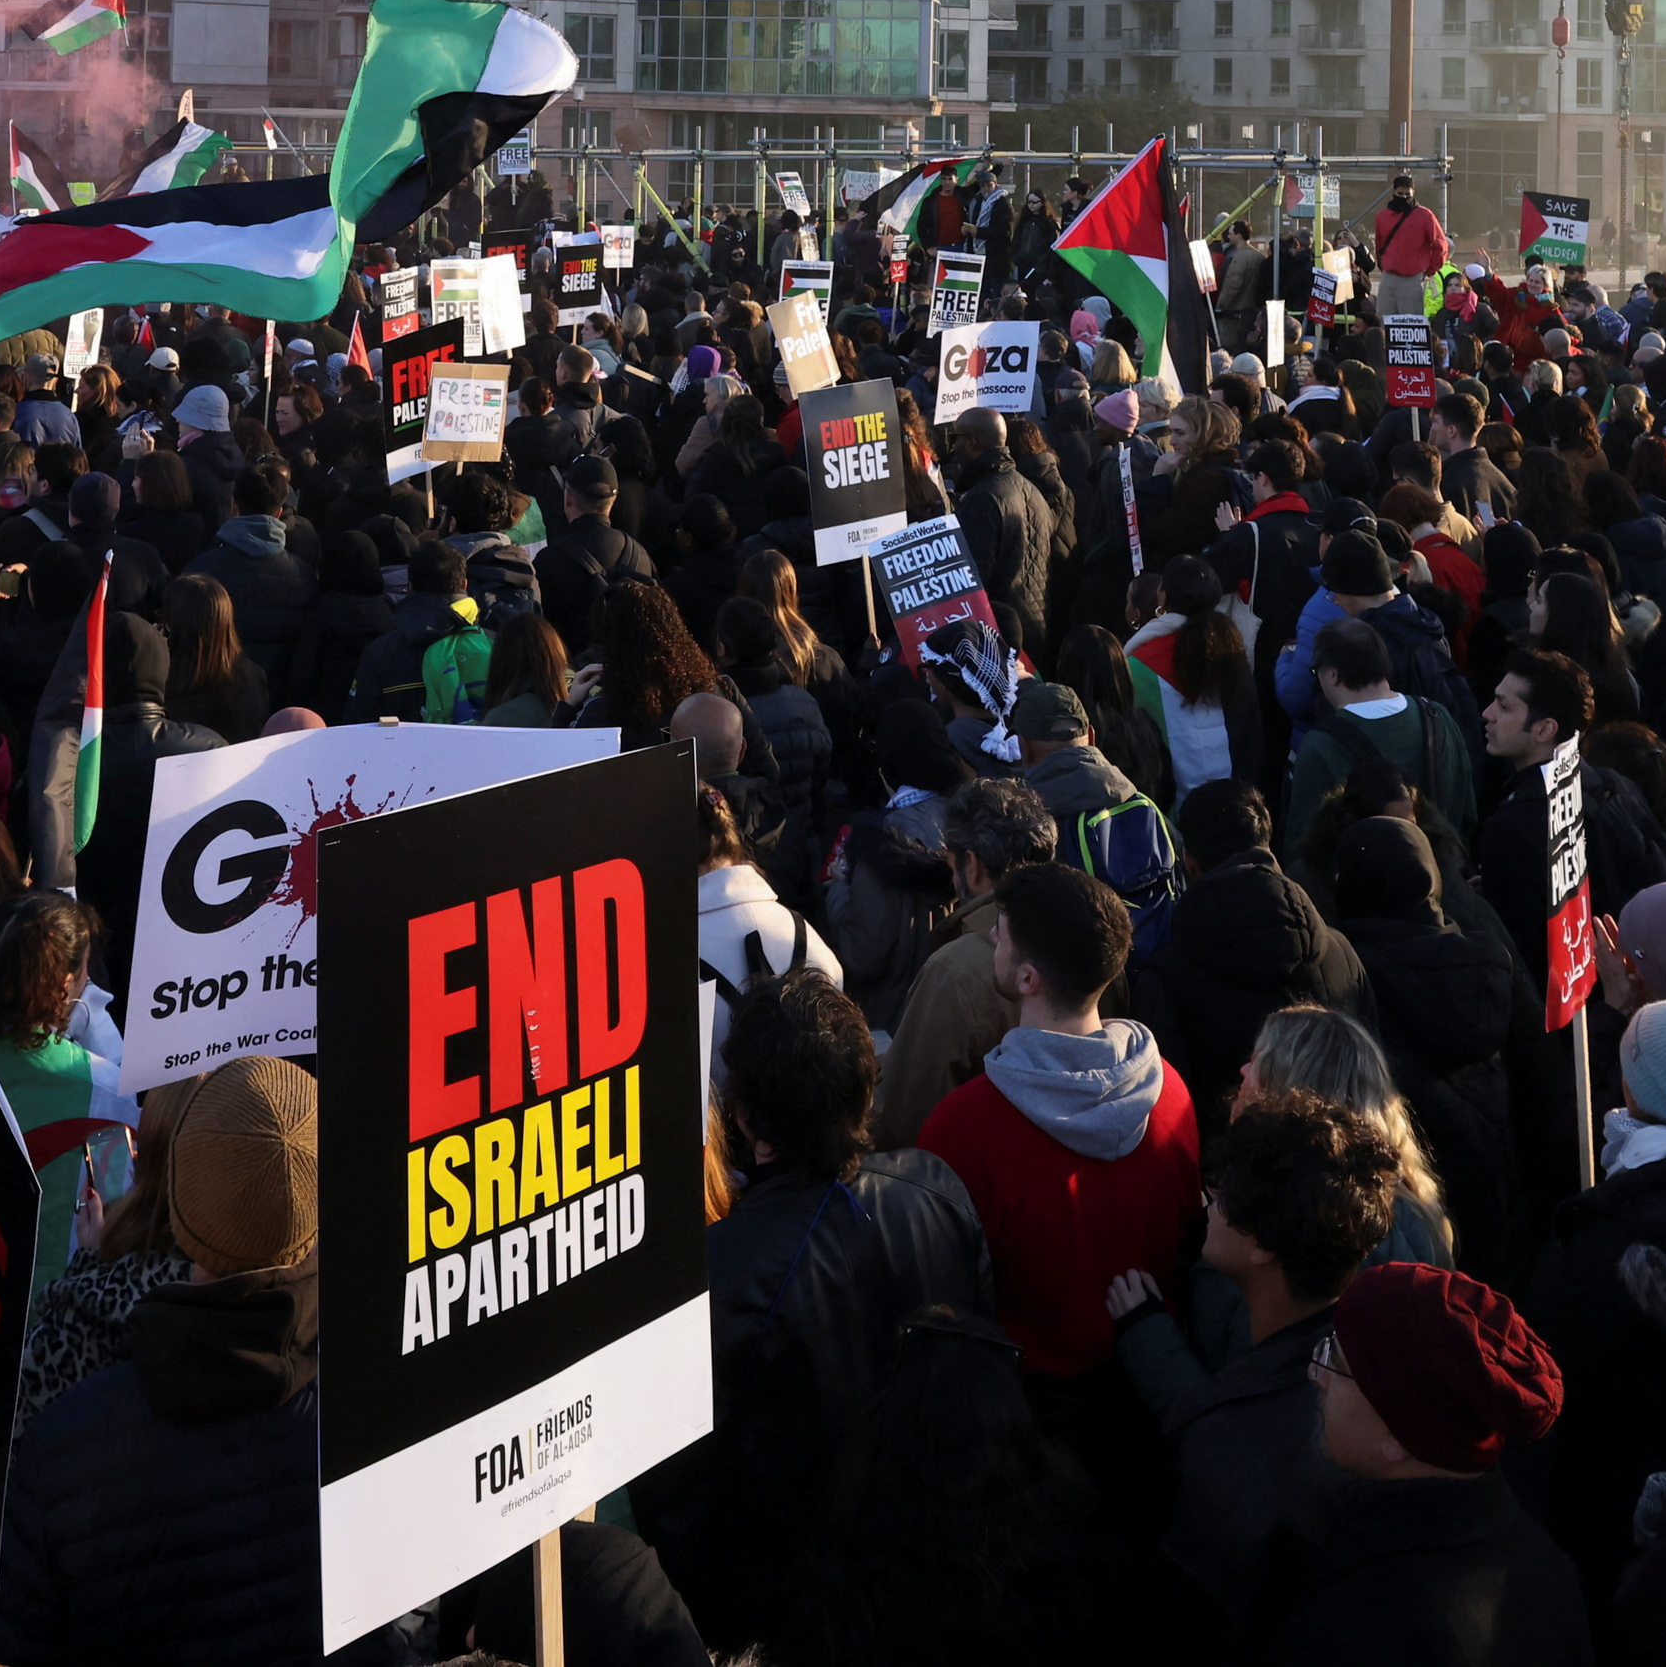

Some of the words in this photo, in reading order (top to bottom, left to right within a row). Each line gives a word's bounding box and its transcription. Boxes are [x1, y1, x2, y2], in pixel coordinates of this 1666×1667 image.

[499, 149, 528, 159] FREE
[784, 191, 807, 203] FREE
[1546, 199, 1578, 217] SAVE
[1552, 223, 1575, 239] THE
[1533, 244, 1578, 261] CHILDREN
[563, 261, 581, 274] END
[581, 258, 597, 272] THE
[386, 280, 414, 299] FREEDOM
[562, 272, 596, 293] SIEGE
[1313, 275, 1335, 289] FREEDOM
[933, 290, 978, 313] FREE
[1311, 287, 1335, 305] PALESTINE
[384, 298, 416, 319] PALESTINE
[434, 302, 480, 324] FREE
[932, 310, 975, 323] PALESTINE
[1389, 328, 1428, 343] FREEDOM
[1388, 349, 1432, 366] PALESTINE
[1397, 369, 1426, 385] الحرية
[438, 381, 481, 405] FREE
[941, 393, 960, 405] Stop
[962, 389, 974, 400] the
[977, 382, 1026, 396] massacre
[434, 410, 500, 435] PALESTINE
[820, 417, 856, 450] END
[854, 412, 887, 444] THE
[823, 441, 890, 489] SIEGE
[847, 531, 861, 543] FOA
[882, 534, 961, 579] FREEDOM
[921, 567, 935, 578] for
[890, 566, 977, 614] PALESTINE
[916, 601, 974, 632] الحية
[150, 969, 249, 1020] Stop
[408, 858, 648, 1143] END
[164, 1050, 201, 1070] Stop
[206, 1040, 232, 1058] the
[237, 1033, 270, 1053] War
[407, 1064, 641, 1264] ISRAELI
[401, 1173, 645, 1356] APARTHEID
[536, 1394, 593, 1448] FRIENDS
[537, 1446, 550, 1470] OF
[553, 1423, 593, 1462] AL-AQSA
[475, 1435, 524, 1504] FOA
[500, 1469, 572, 1517] @friendsofalaqsa
